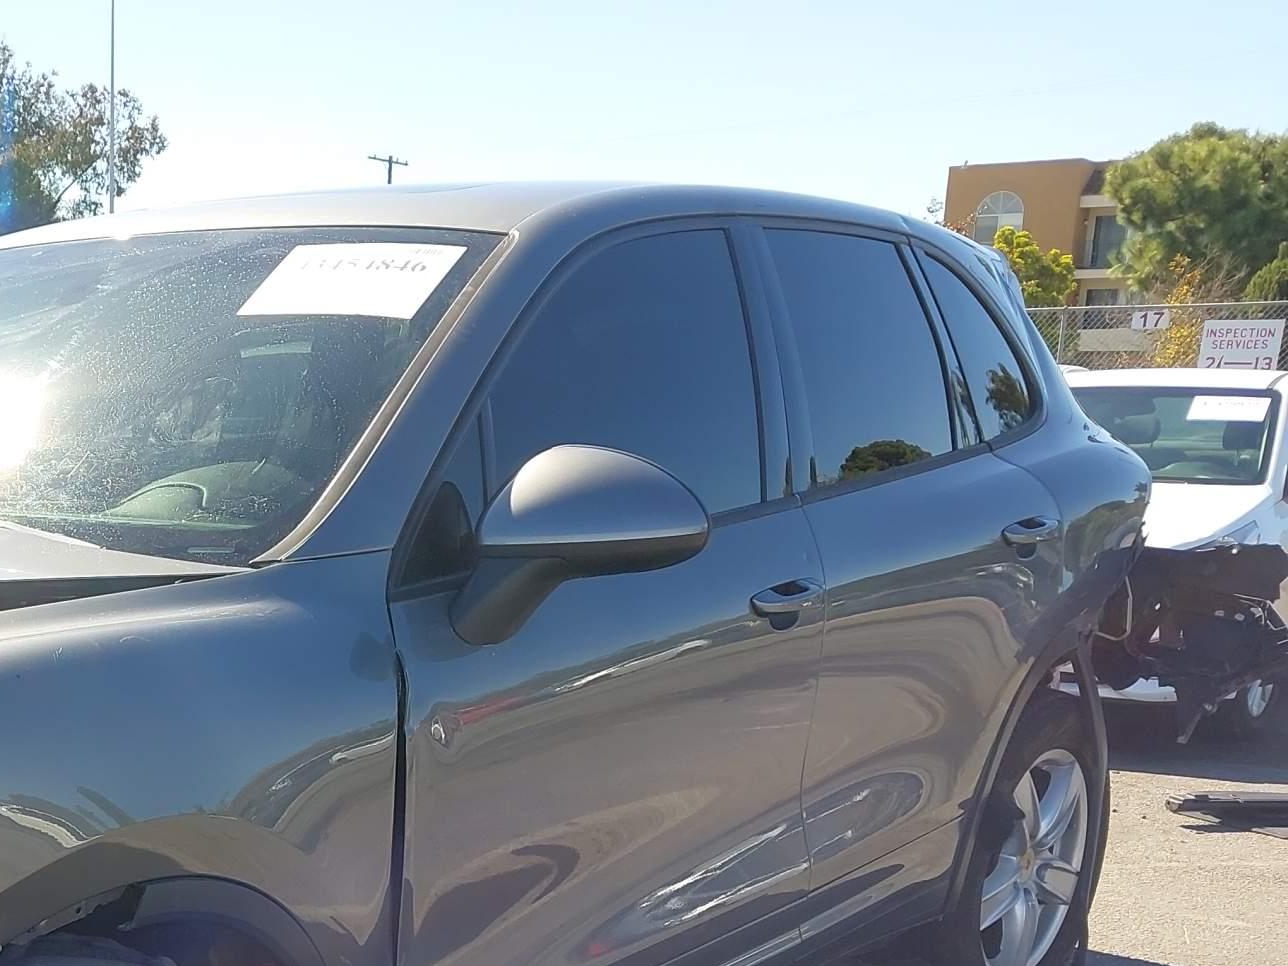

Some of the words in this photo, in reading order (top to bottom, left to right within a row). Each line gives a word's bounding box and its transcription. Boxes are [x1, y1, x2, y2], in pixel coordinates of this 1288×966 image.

[1139, 311, 1165, 328] 17
[1206, 327, 1276, 338] INSPECTION
[1211, 339, 1269, 350] SERVICES
